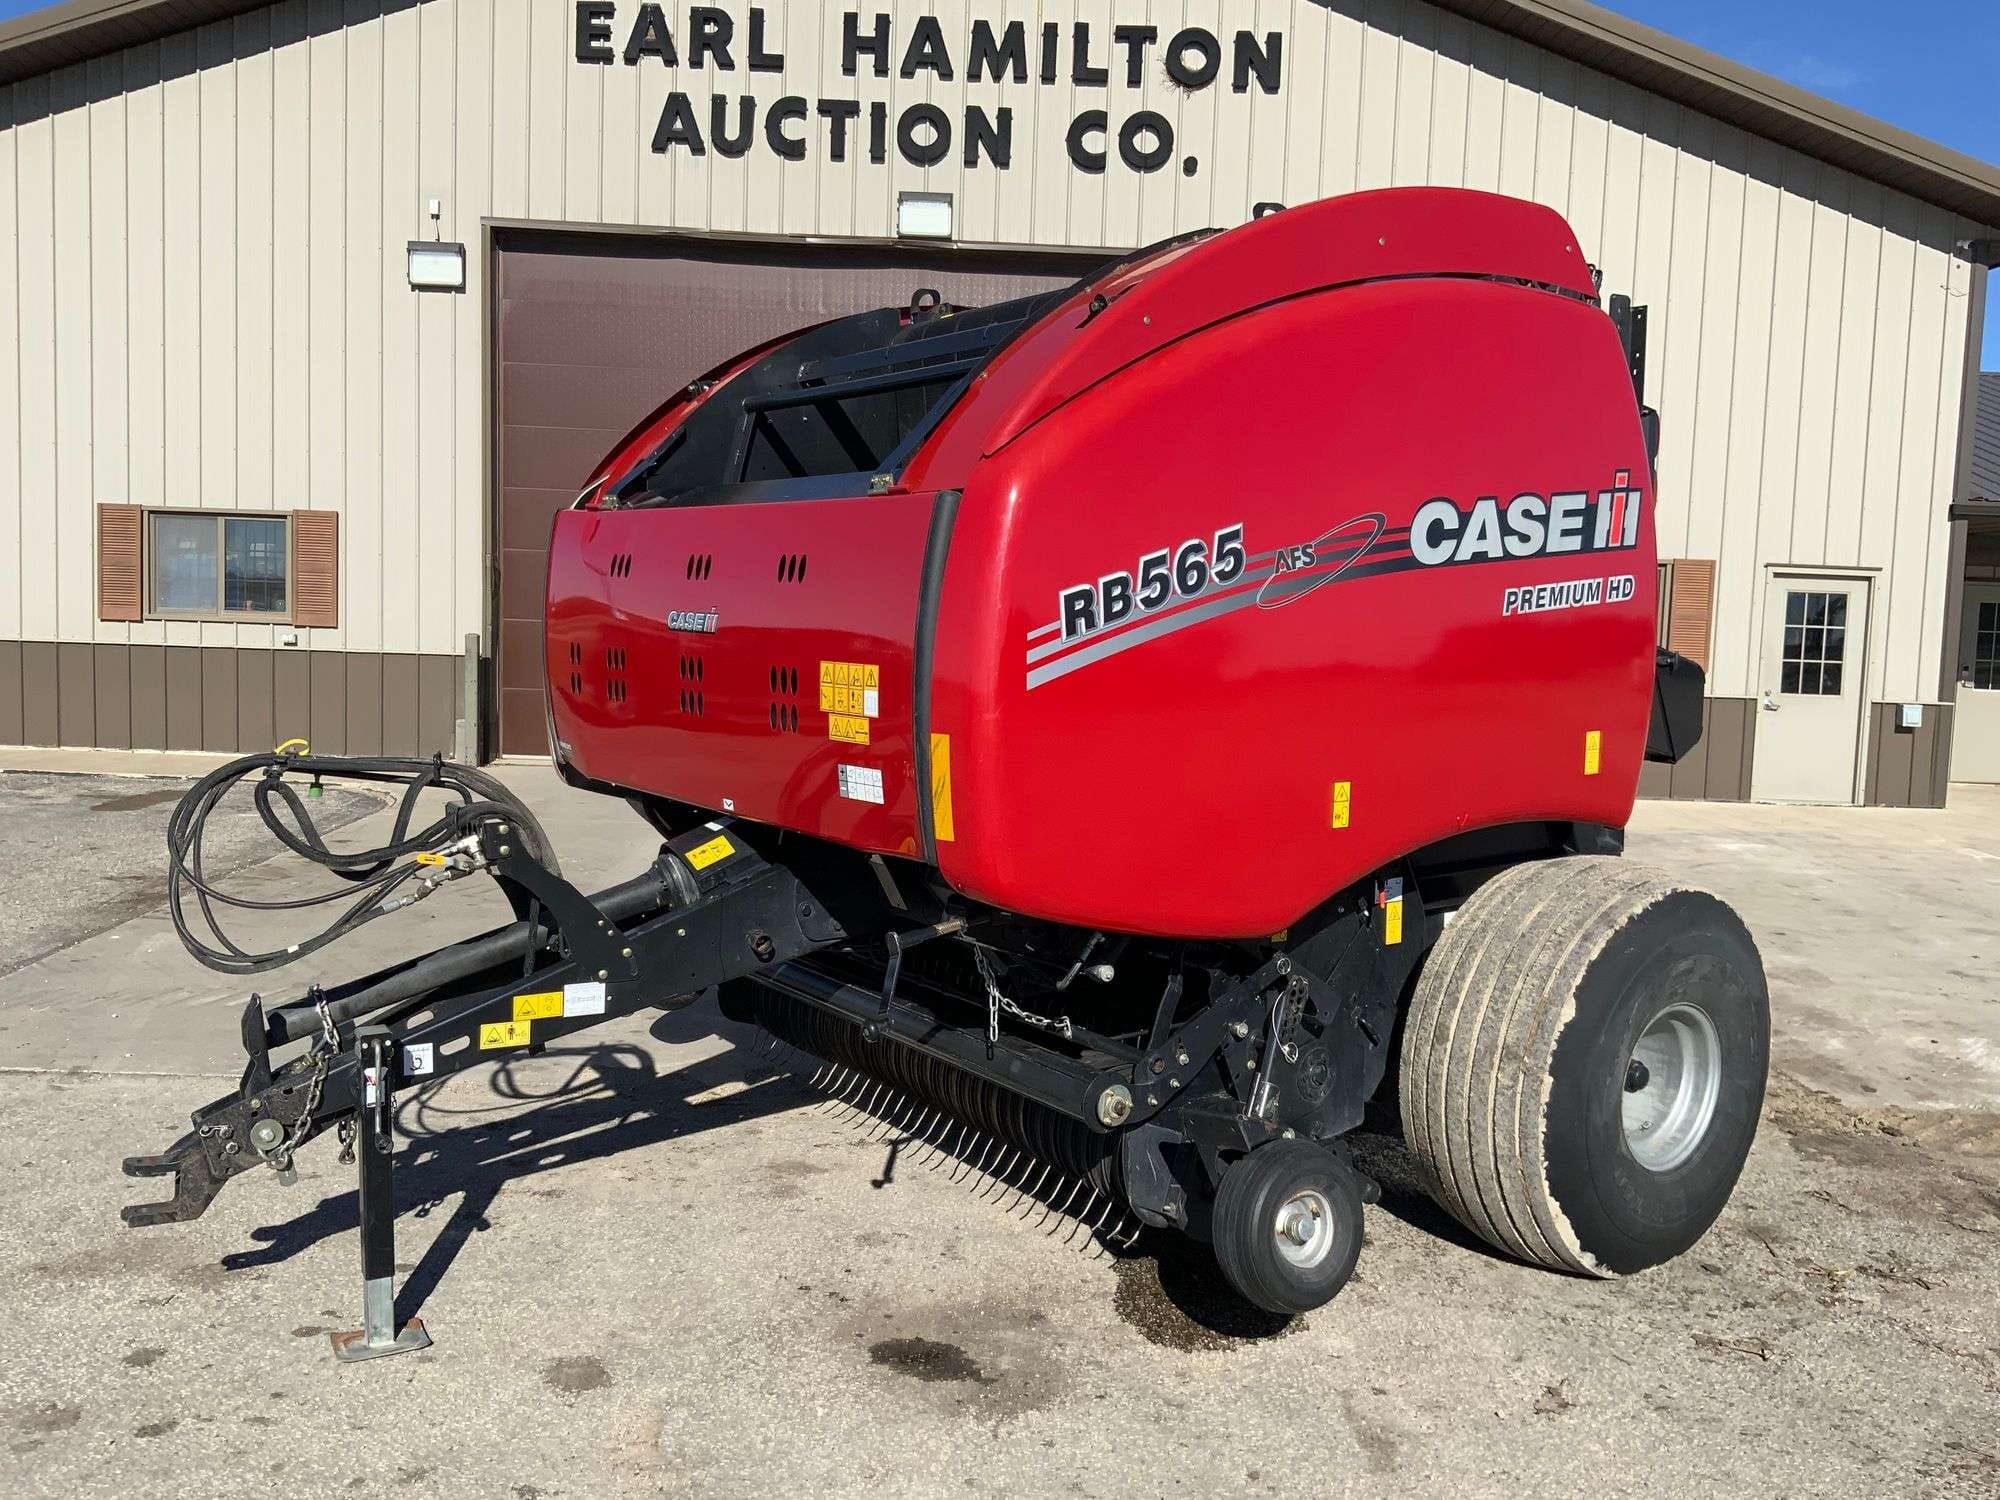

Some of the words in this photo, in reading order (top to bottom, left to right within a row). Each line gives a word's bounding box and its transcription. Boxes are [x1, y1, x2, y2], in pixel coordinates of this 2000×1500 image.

[576, 1, 785, 72] EARL
[841, 11, 1282, 95] HAMILTON
[651, 91, 1013, 169] AUCTION
[1066, 109, 1198, 177] CO.
[1274, 543, 1317, 575] AFS
[1409, 493, 1588, 566] CASE
[1059, 522, 1246, 643] RB565
[1503, 578, 1602, 616] PREMIUM
[1607, 575, 1635, 603] HD
